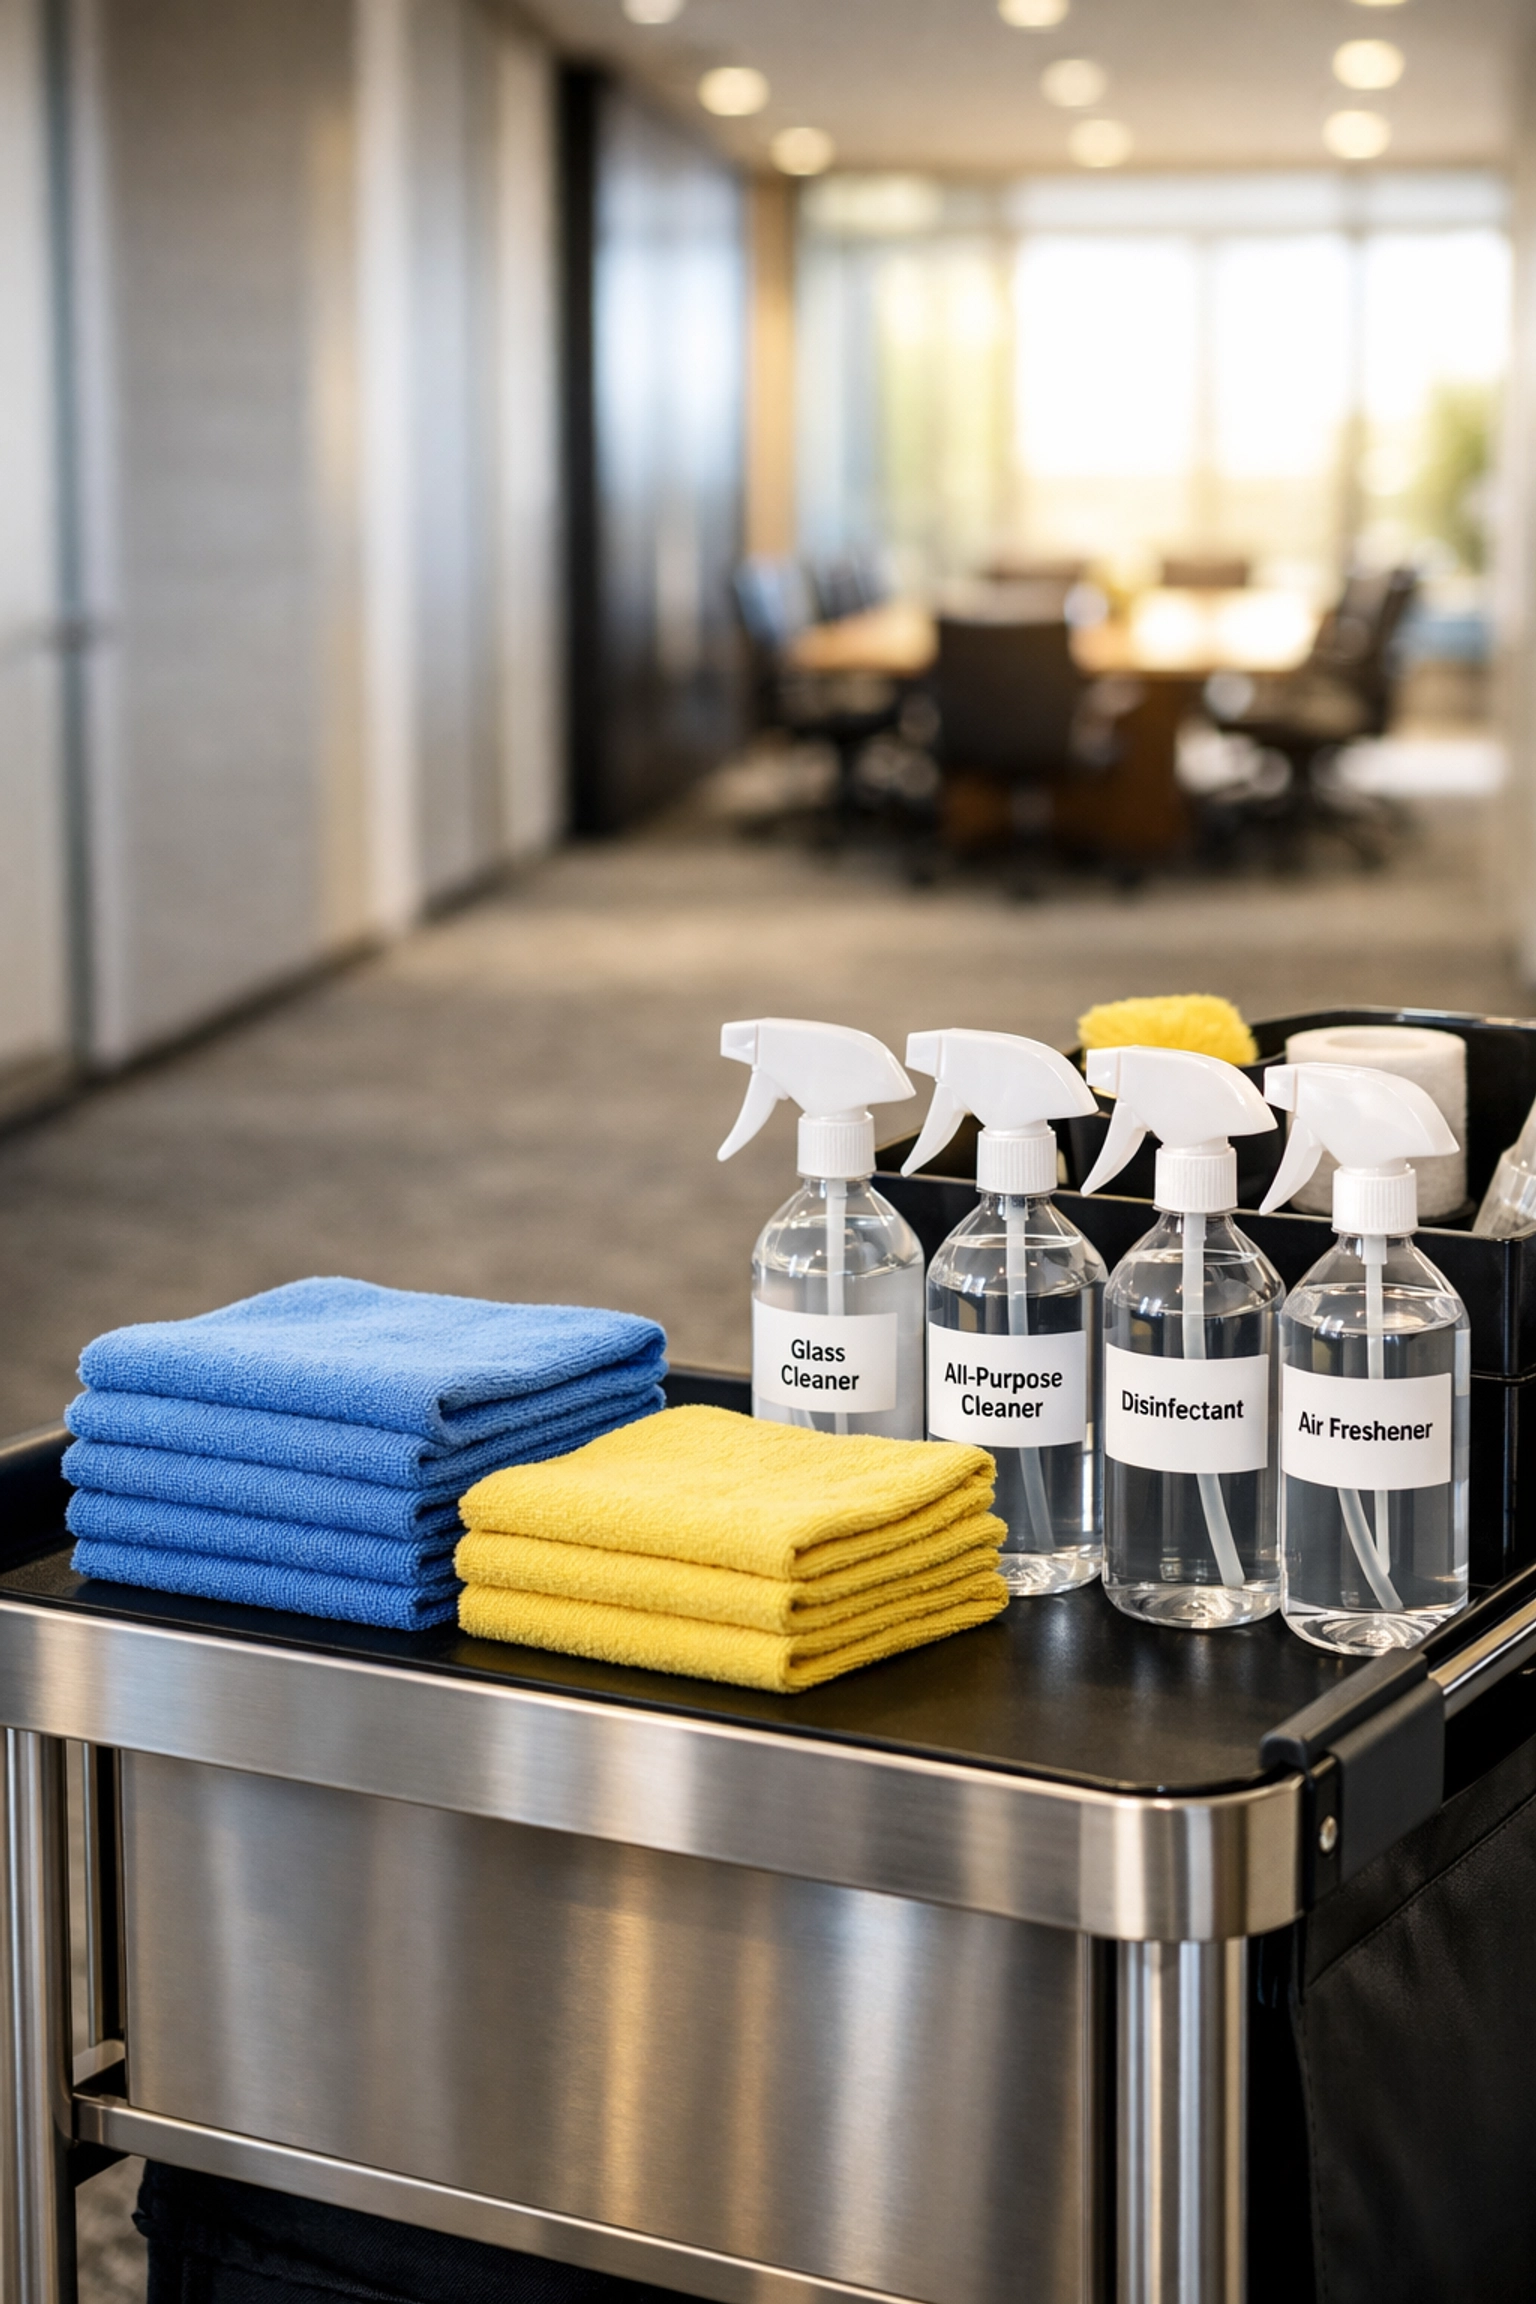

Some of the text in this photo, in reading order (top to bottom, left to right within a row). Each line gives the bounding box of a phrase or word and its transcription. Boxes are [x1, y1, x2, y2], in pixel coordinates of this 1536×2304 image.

[791, 1339, 846, 1362] Glass
[781, 1364, 860, 1391] Cleaner
[944, 1362, 1063, 1395] All-Purpose
[961, 1394, 1044, 1419] Cleaner
[1122, 1390, 1244, 1421] Disinfectant
[1298, 1411, 1434, 1442] Air Freshener
